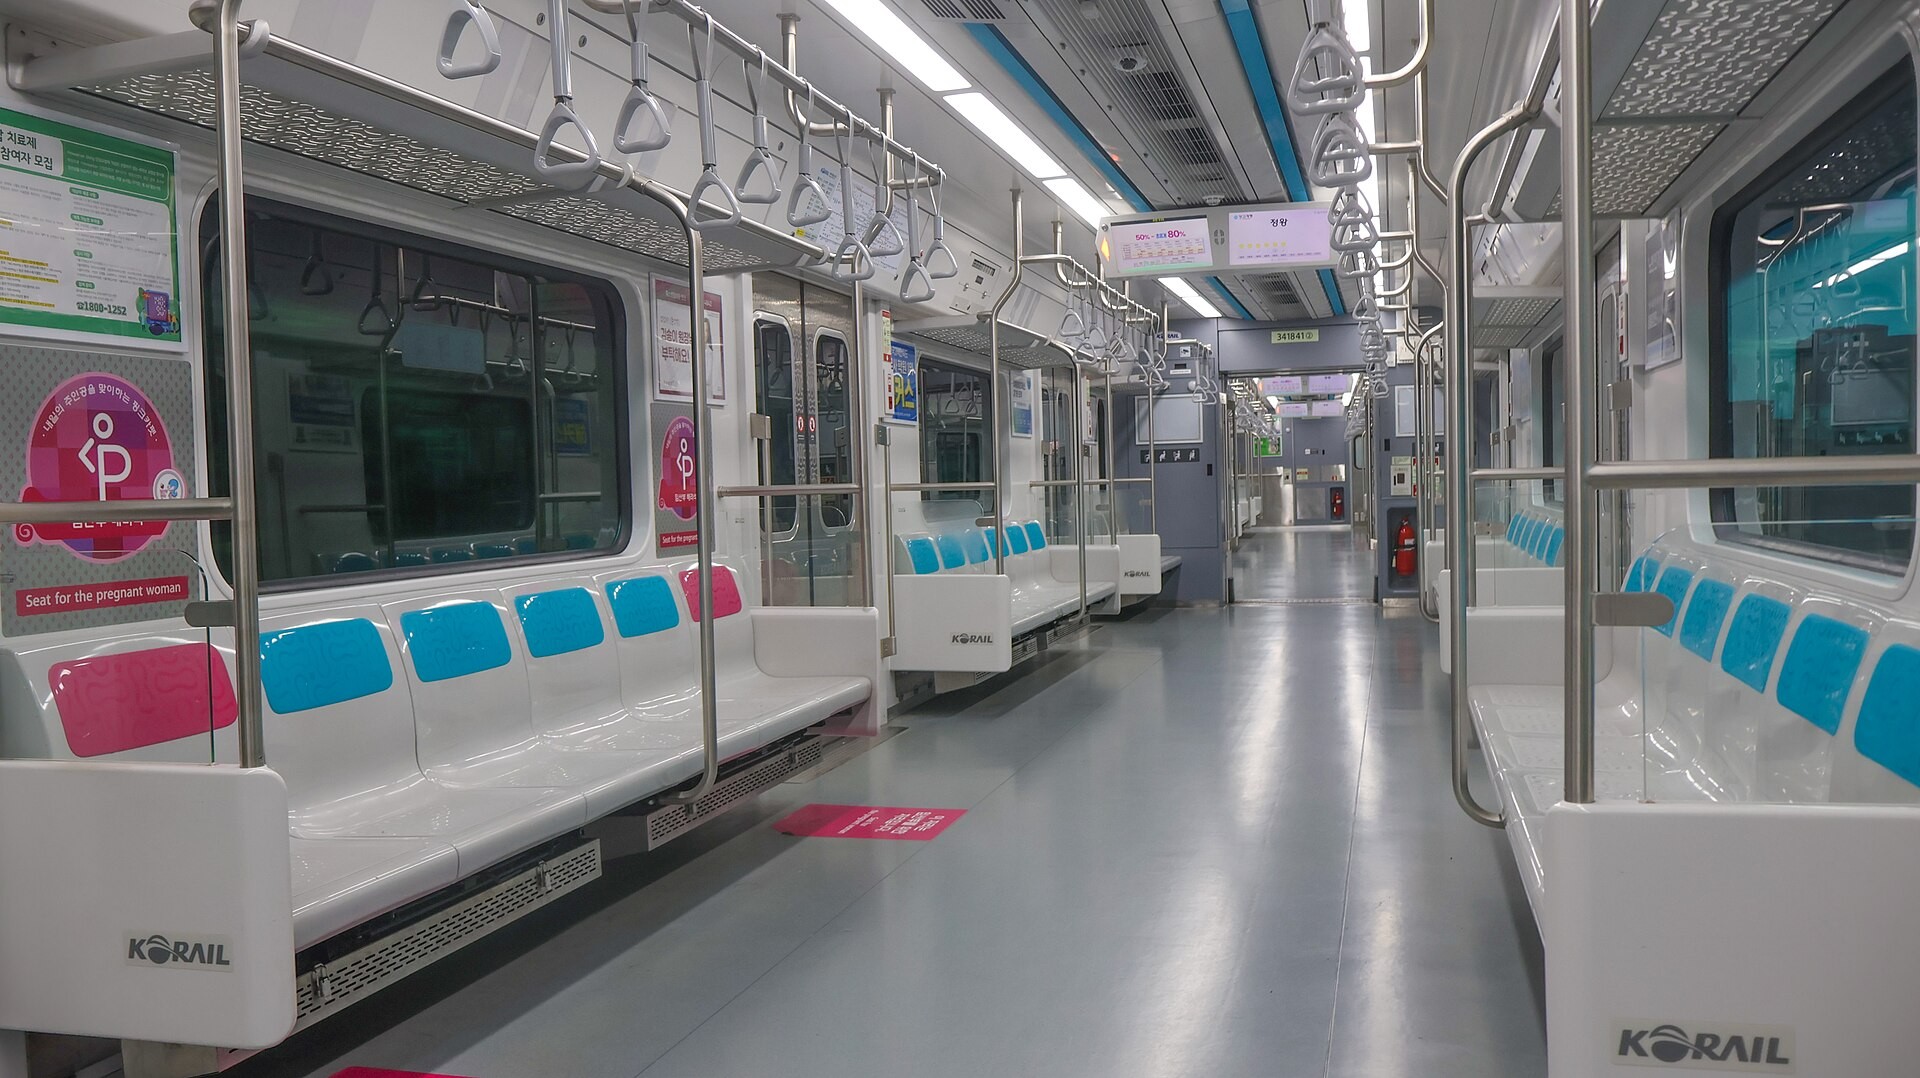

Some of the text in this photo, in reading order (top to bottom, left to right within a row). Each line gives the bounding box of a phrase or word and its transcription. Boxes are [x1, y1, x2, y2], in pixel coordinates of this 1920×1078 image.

[7, 131, 37, 149] 치료제
[1, 146, 31, 165] 참여자
[34, 155, 53, 171] 모집
[1270, 218, 1288, 227] 정왕
[1167, 229, 1187, 239] 80%
[84, 301, 127, 316] 1800-1252
[662, 346, 690, 363] 부탁해요!
[43, 383, 157, 437] 내일의 주인공을 맞이하는 핑크카펫
[1123, 570, 1151, 578] KORAIL
[26, 583, 181, 608] Seat for the pregnant woman
[951, 632, 993, 644] KORAIL
[128, 934, 230, 965] KORAIL
[1618, 1024, 1790, 1064] KORAIL
